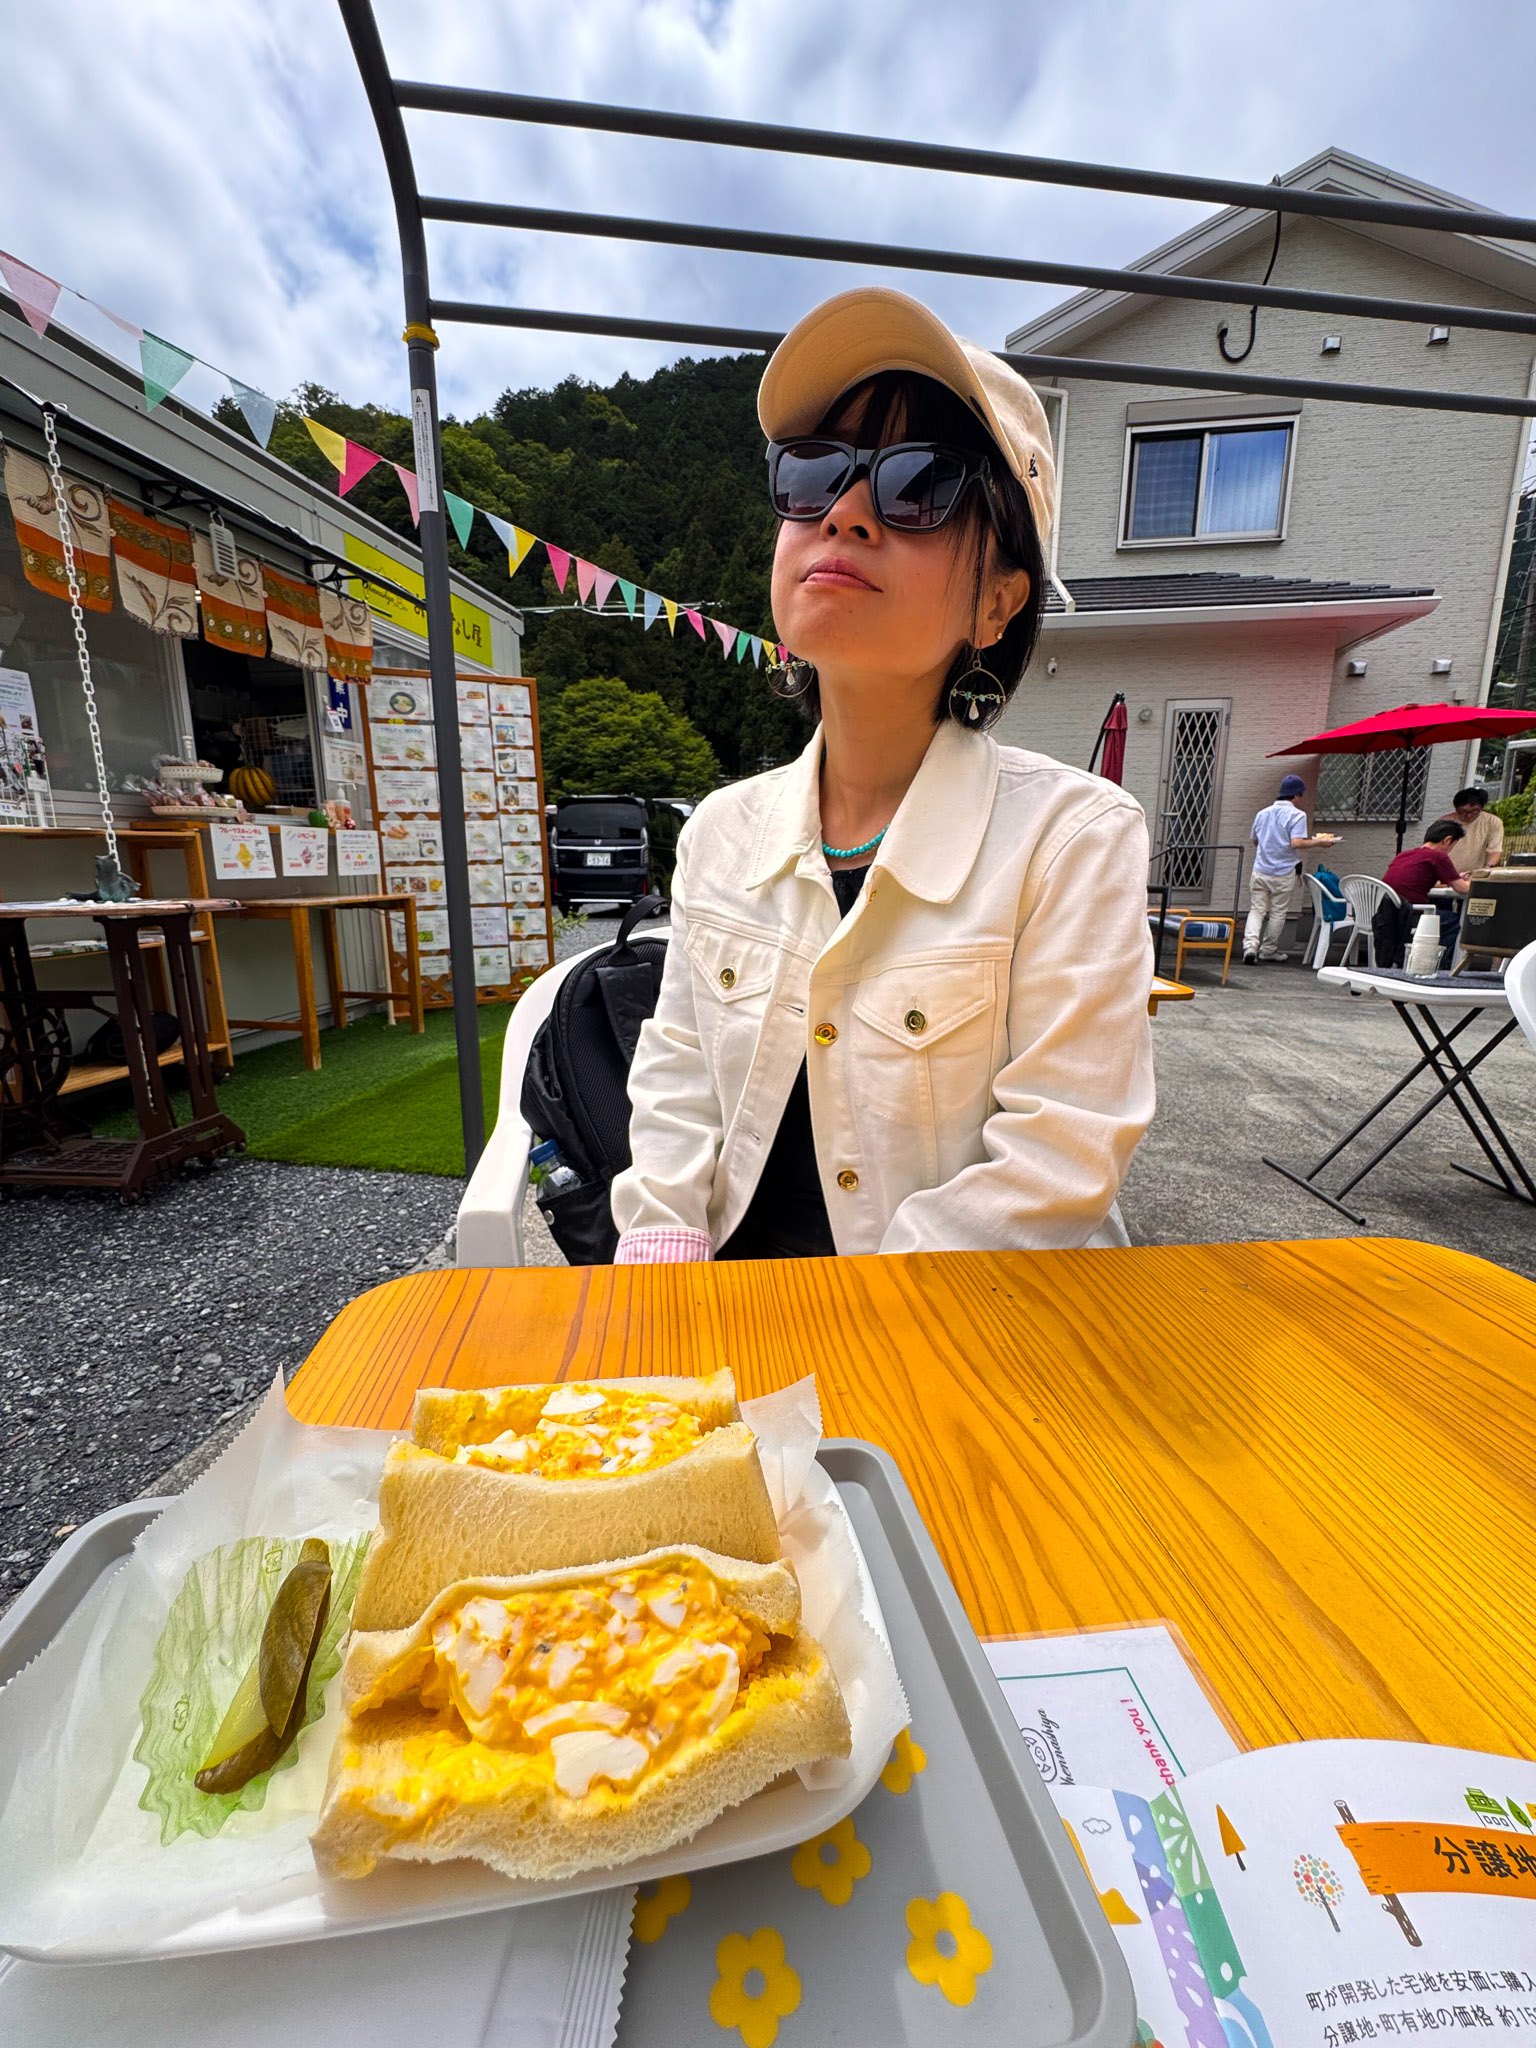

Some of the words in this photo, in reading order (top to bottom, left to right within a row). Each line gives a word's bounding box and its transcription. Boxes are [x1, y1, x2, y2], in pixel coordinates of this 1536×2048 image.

[1127, 1707, 1151, 1736] you
[1143, 1738, 1175, 1786] thank
[1433, 1836, 1536, 1879] 分譲地
[1305, 1969, 1536, 2012] 町が開発した宅地を安価に購入
[1495, 2003, 1536, 2028] 約15
